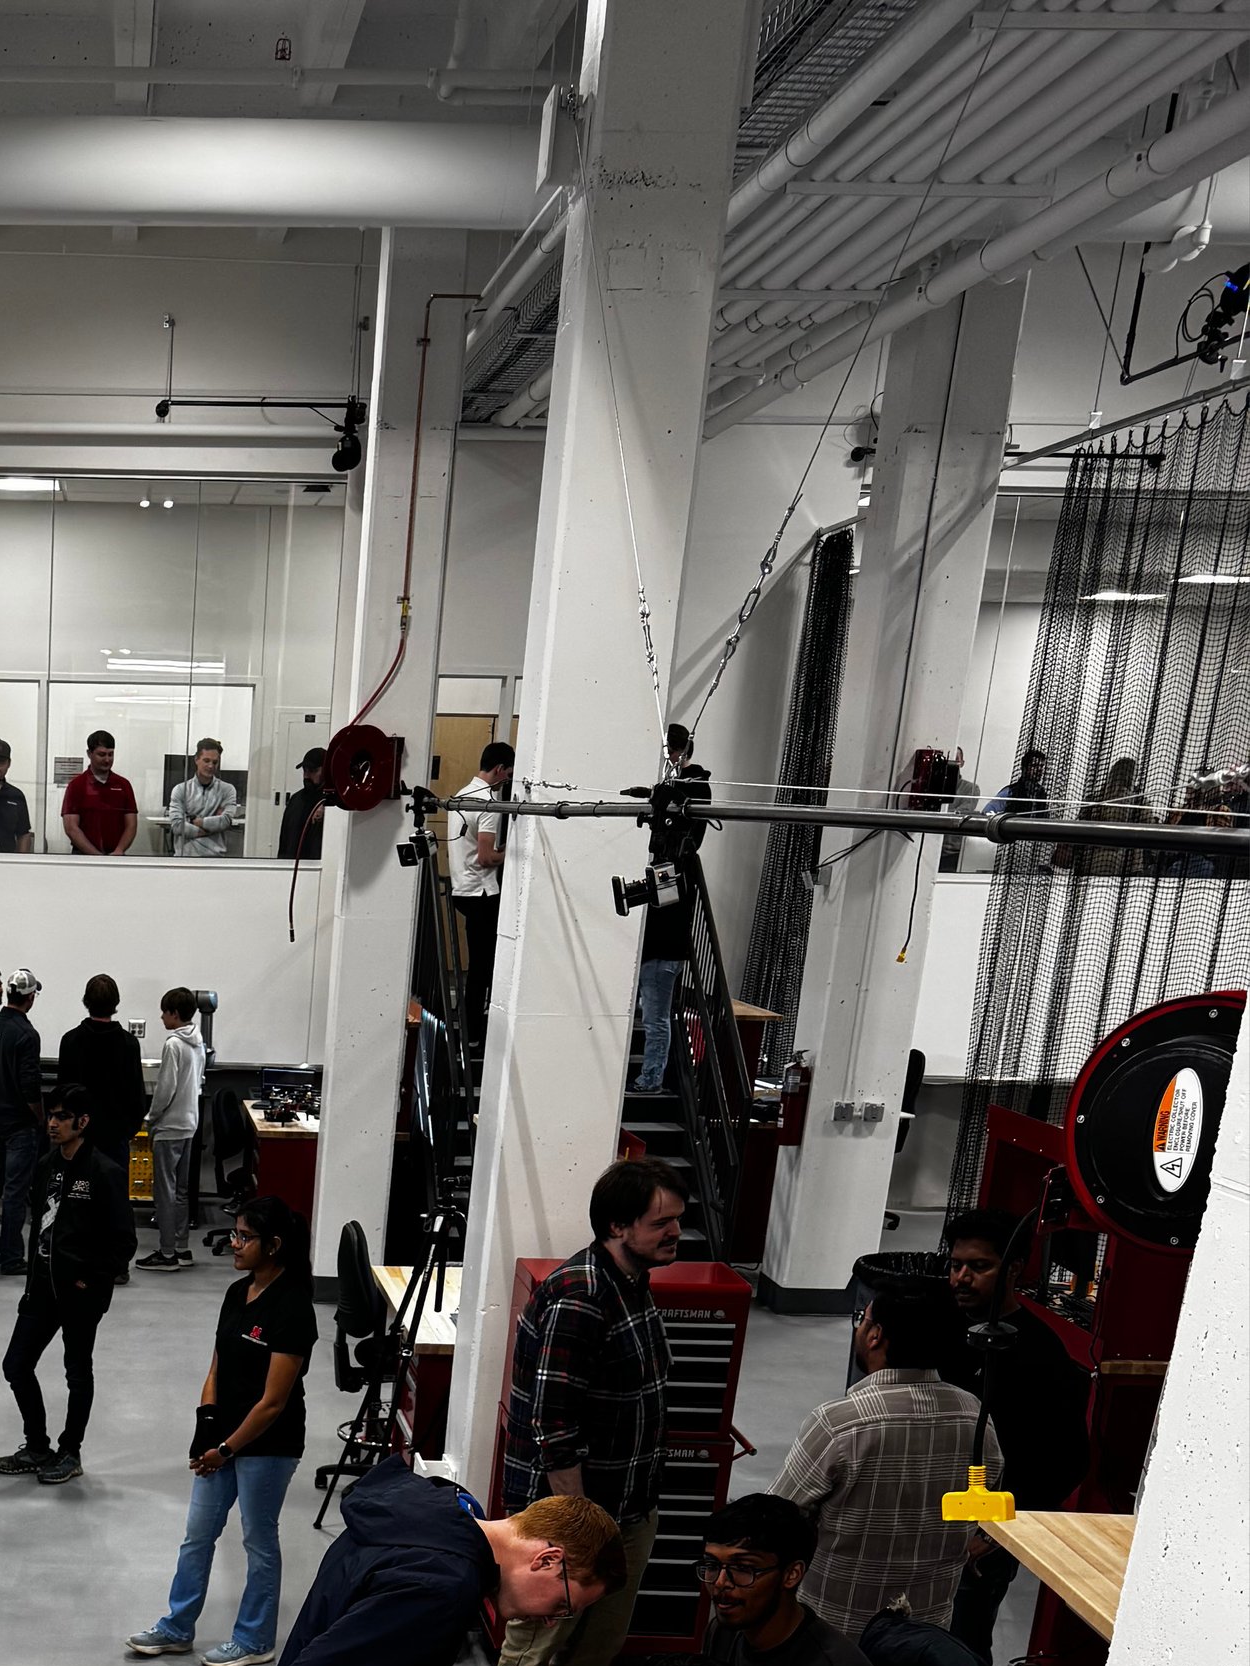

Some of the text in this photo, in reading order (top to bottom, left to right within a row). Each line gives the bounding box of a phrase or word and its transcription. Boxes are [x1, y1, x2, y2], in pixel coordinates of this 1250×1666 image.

[1157, 1110, 1171, 1141] WARNING
[1167, 1089, 1181, 1151] ELECTRIC COLLECTOR
[1186, 1102, 1198, 1152] REMOVING COVER
[1179, 1131, 1187, 1152] POWER
